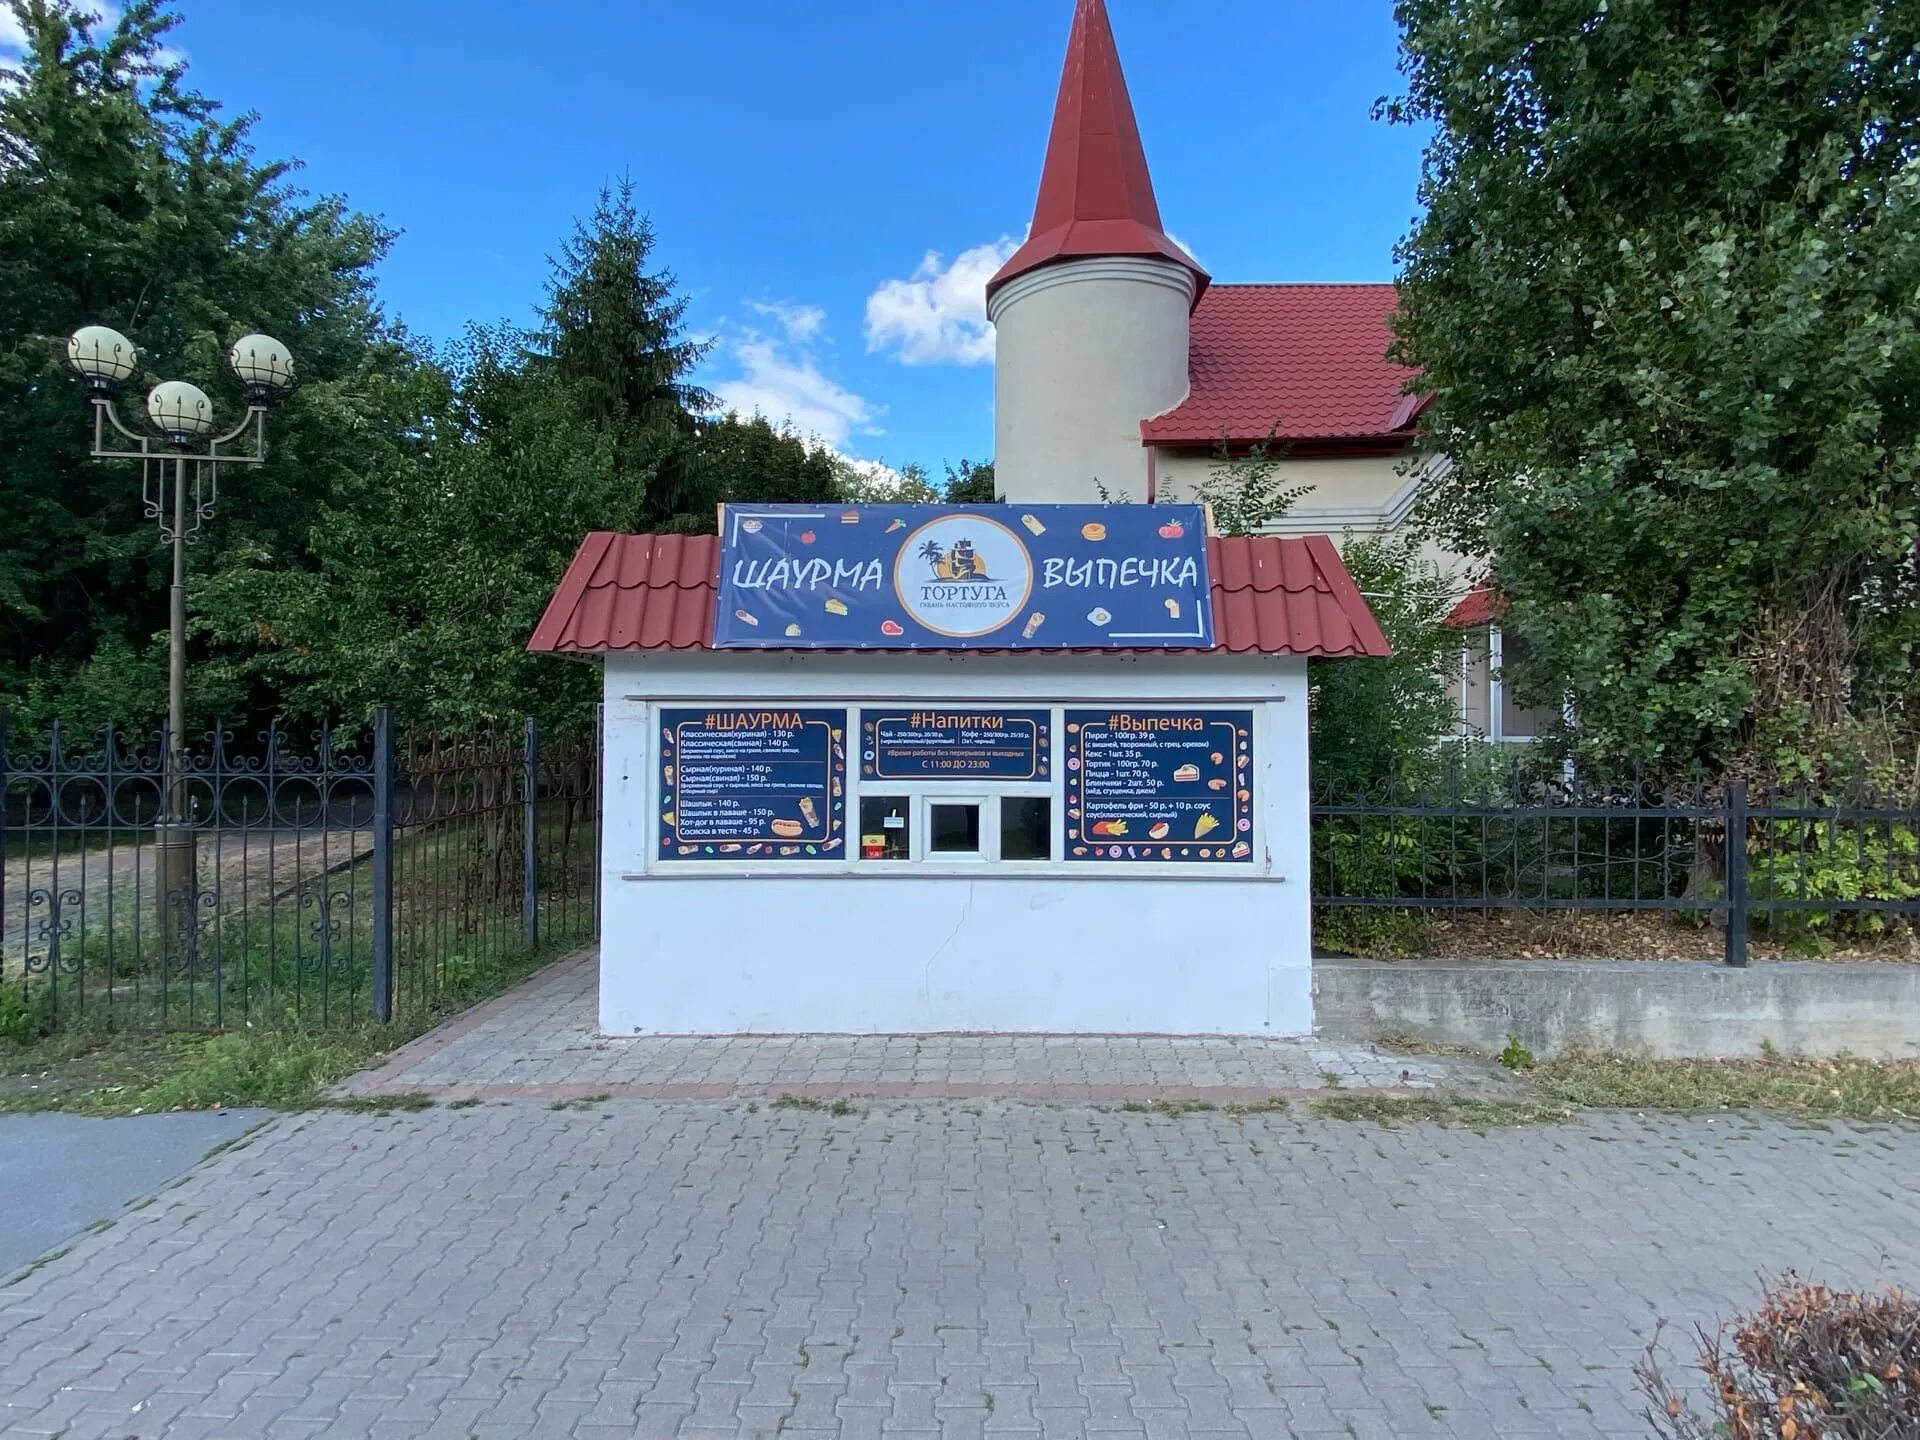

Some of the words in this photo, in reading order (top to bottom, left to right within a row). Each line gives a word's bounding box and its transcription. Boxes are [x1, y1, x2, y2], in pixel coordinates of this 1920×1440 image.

[732, 557, 883, 591] ШАУРМА
[1042, 557, 1198, 589] ВЫПЕЧКА
[920, 586, 1007, 600] ТОРТУГА
[705, 714, 803, 730] #ШАУРМА
[910, 712, 1003, 729] #Напитки
[1109, 715, 1203, 731] #Выпечка
